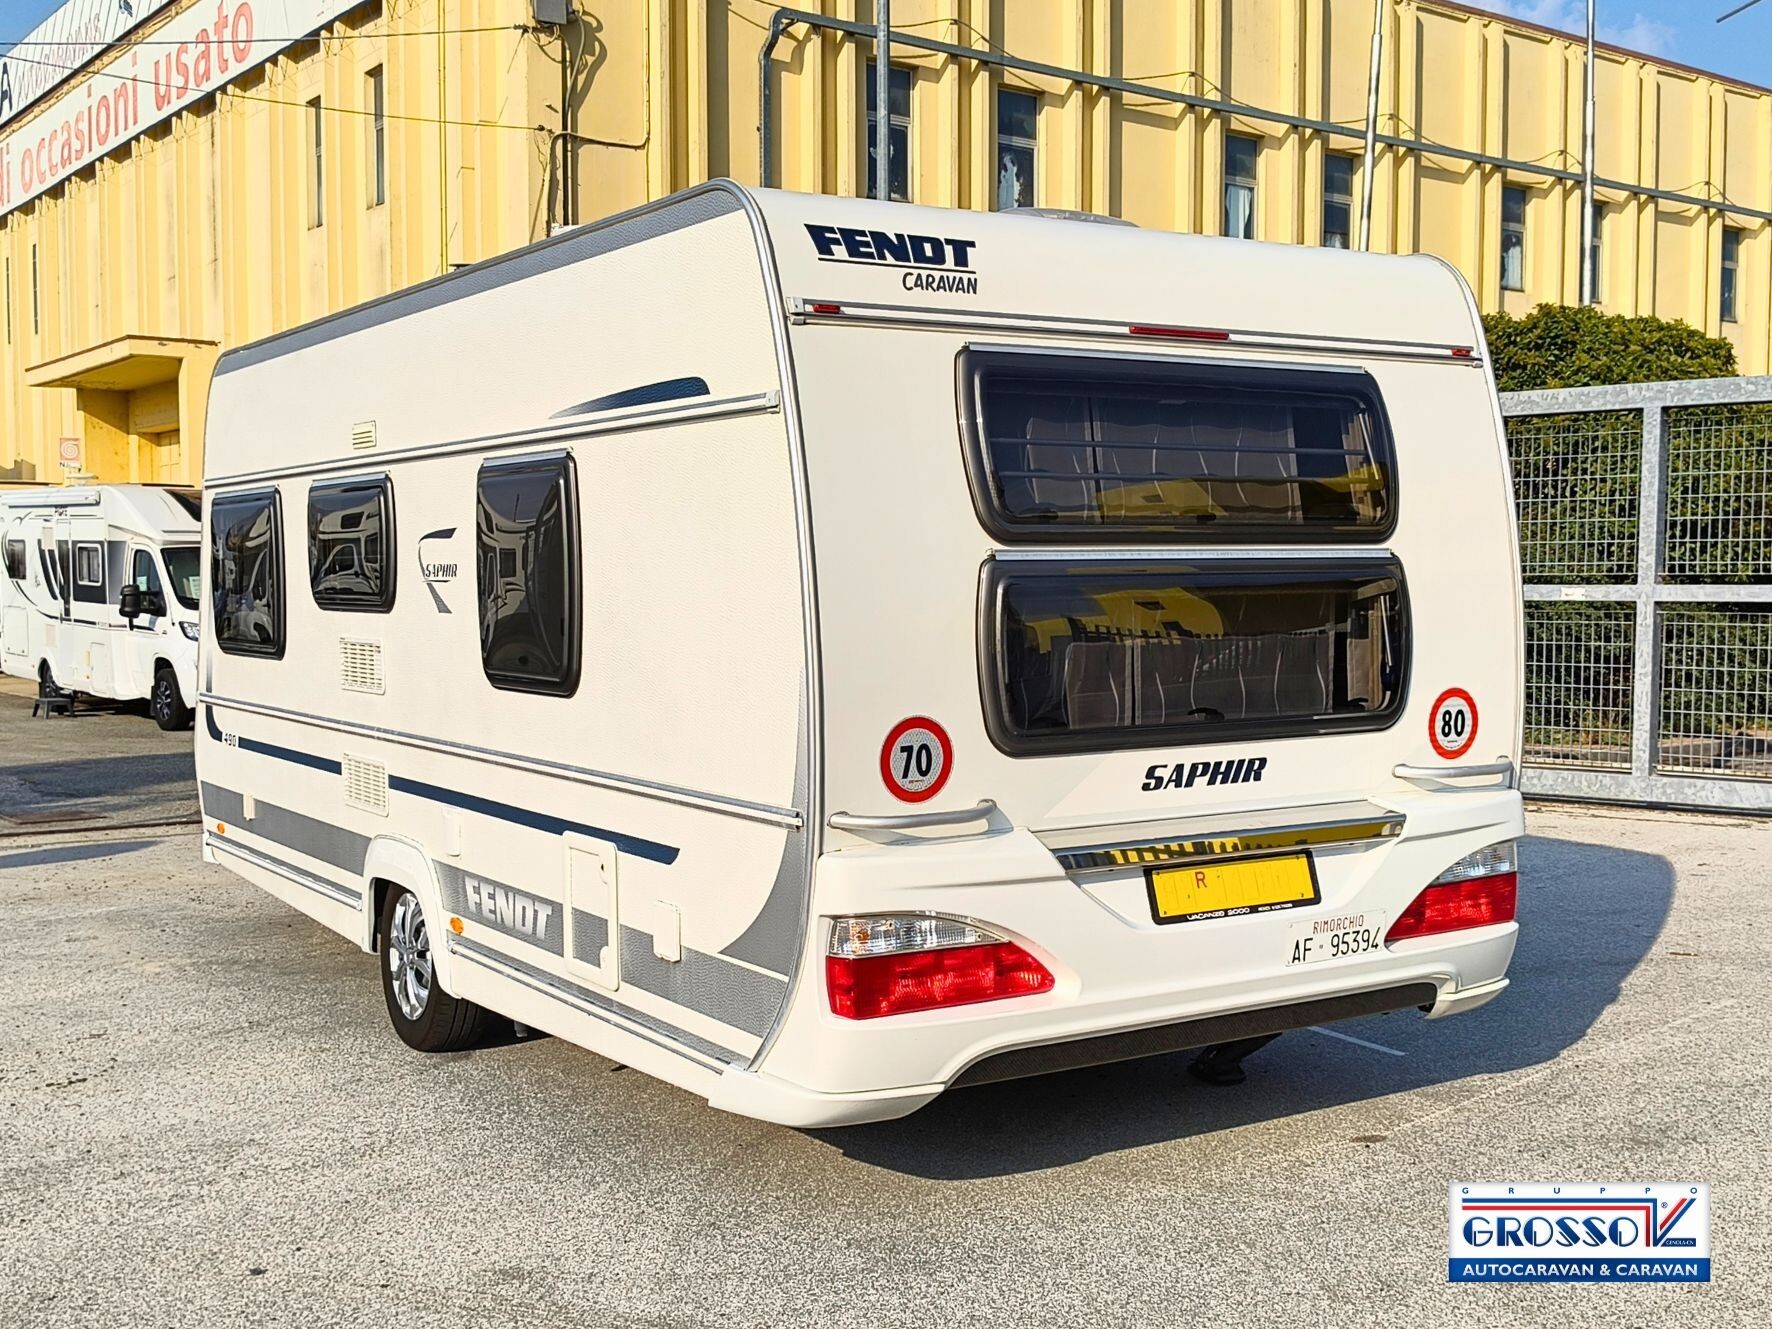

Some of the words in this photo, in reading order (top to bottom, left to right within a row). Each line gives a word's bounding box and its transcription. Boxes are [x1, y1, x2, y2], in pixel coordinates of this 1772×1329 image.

[20, 50, 138, 195] occasioni
[153, 1, 254, 112] usato
[803, 223, 976, 268] FENDT
[902, 272, 978, 295] CARAVAN
[425, 563, 458, 578] SAPHIR
[1441, 708, 1466, 738] 80
[223, 733, 237, 747] 490
[900, 743, 932, 780] 70
[1141, 757, 1268, 791] SAPHIR
[1194, 871, 1208, 889] R
[464, 875, 553, 941] FENDT
[1227, 907, 1250, 916] 2000
[1312, 914, 1365, 935] RIMORCHIO
[1291, 937, 1314, 964] AF
[1330, 926, 1381, 957] 95394
